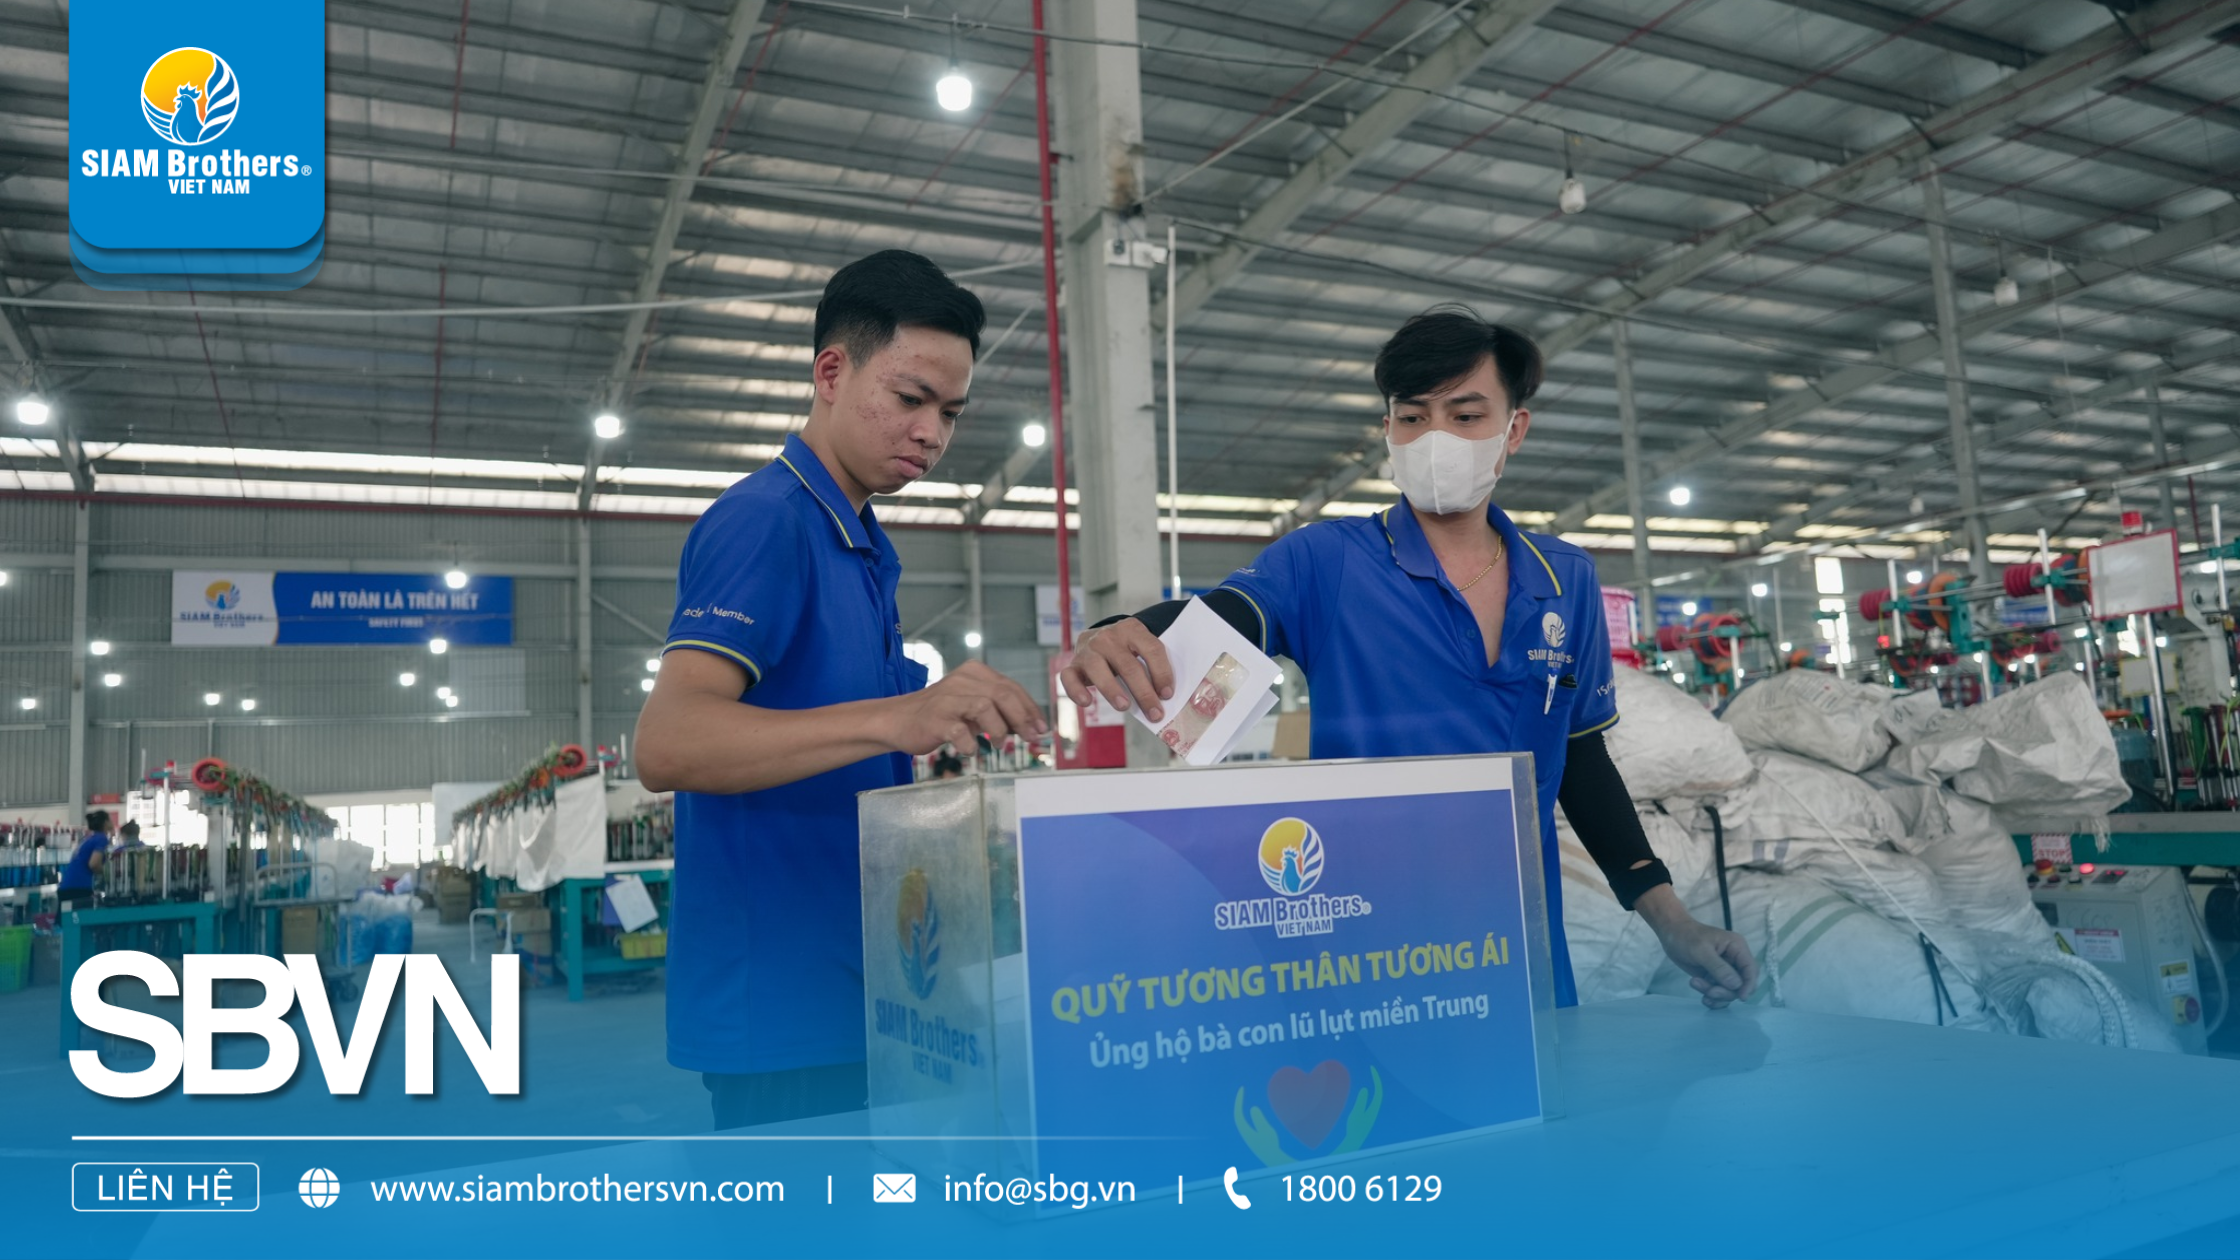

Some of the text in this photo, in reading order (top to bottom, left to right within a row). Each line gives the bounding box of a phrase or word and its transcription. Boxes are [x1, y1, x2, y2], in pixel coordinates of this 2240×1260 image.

[311, 591, 335, 609] AN
[338, 588, 380, 609] TOÀN
[383, 588, 404, 610] LÀ
[407, 589, 447, 611] TRÊN
[712, 606, 755, 626] Member
[1215, 900, 1272, 929] SIAM
[1276, 918, 1333, 938] VIET NAM
[1051, 932, 1510, 1024] QUỸ TƯƠNG THÂN TƯƠNG ÁI
[875, 998, 908, 1044] SIAM
[1090, 993, 1490, 1070] Ủng hộ bà con lũ lụt miền Trung
